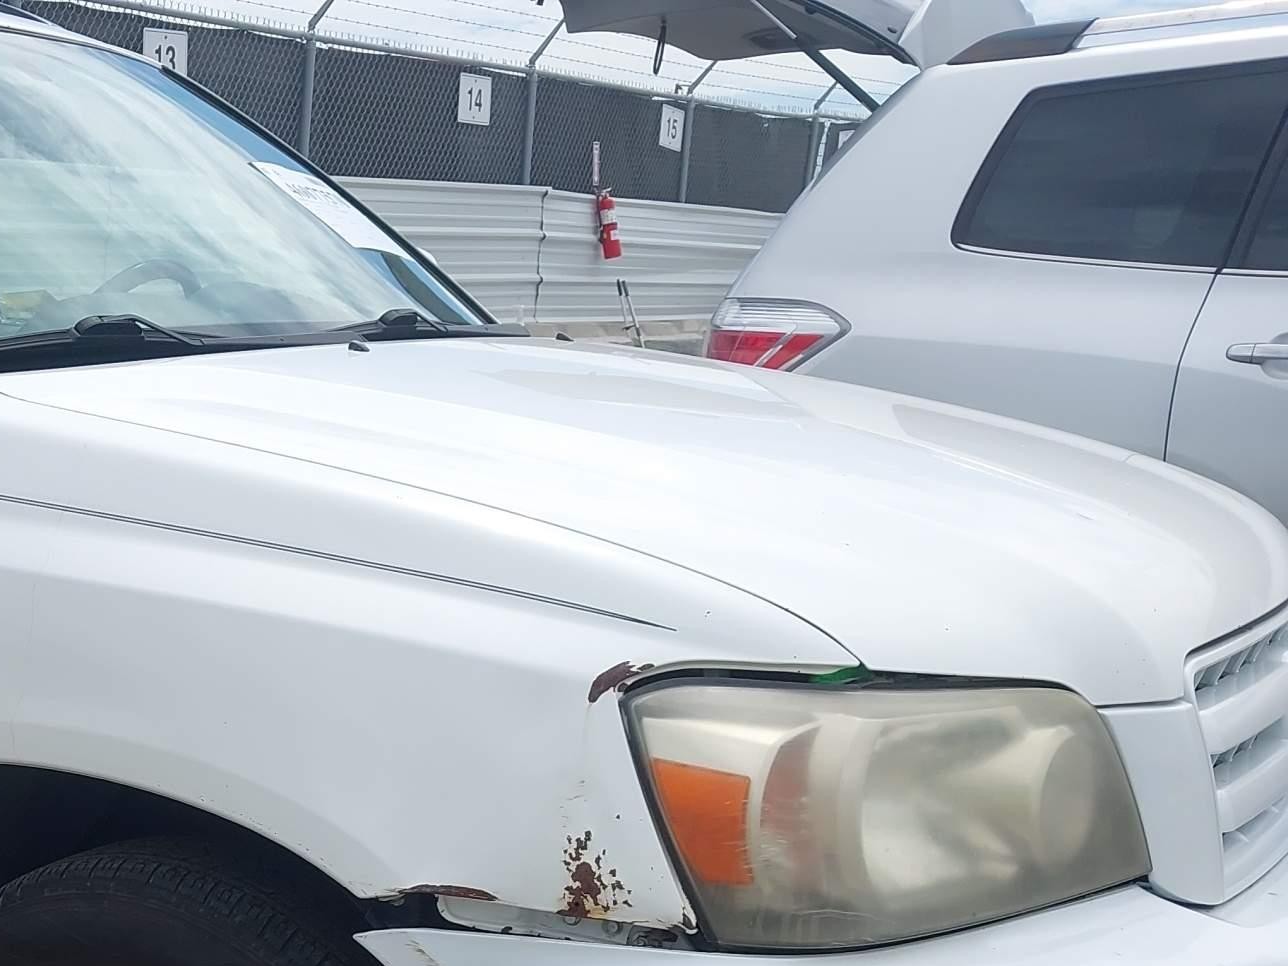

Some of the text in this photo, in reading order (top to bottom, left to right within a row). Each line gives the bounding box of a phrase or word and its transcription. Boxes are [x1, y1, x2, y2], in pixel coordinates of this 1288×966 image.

[155, 44, 176, 70] 13
[467, 87, 482, 113] 14
[667, 117, 678, 139] 15
